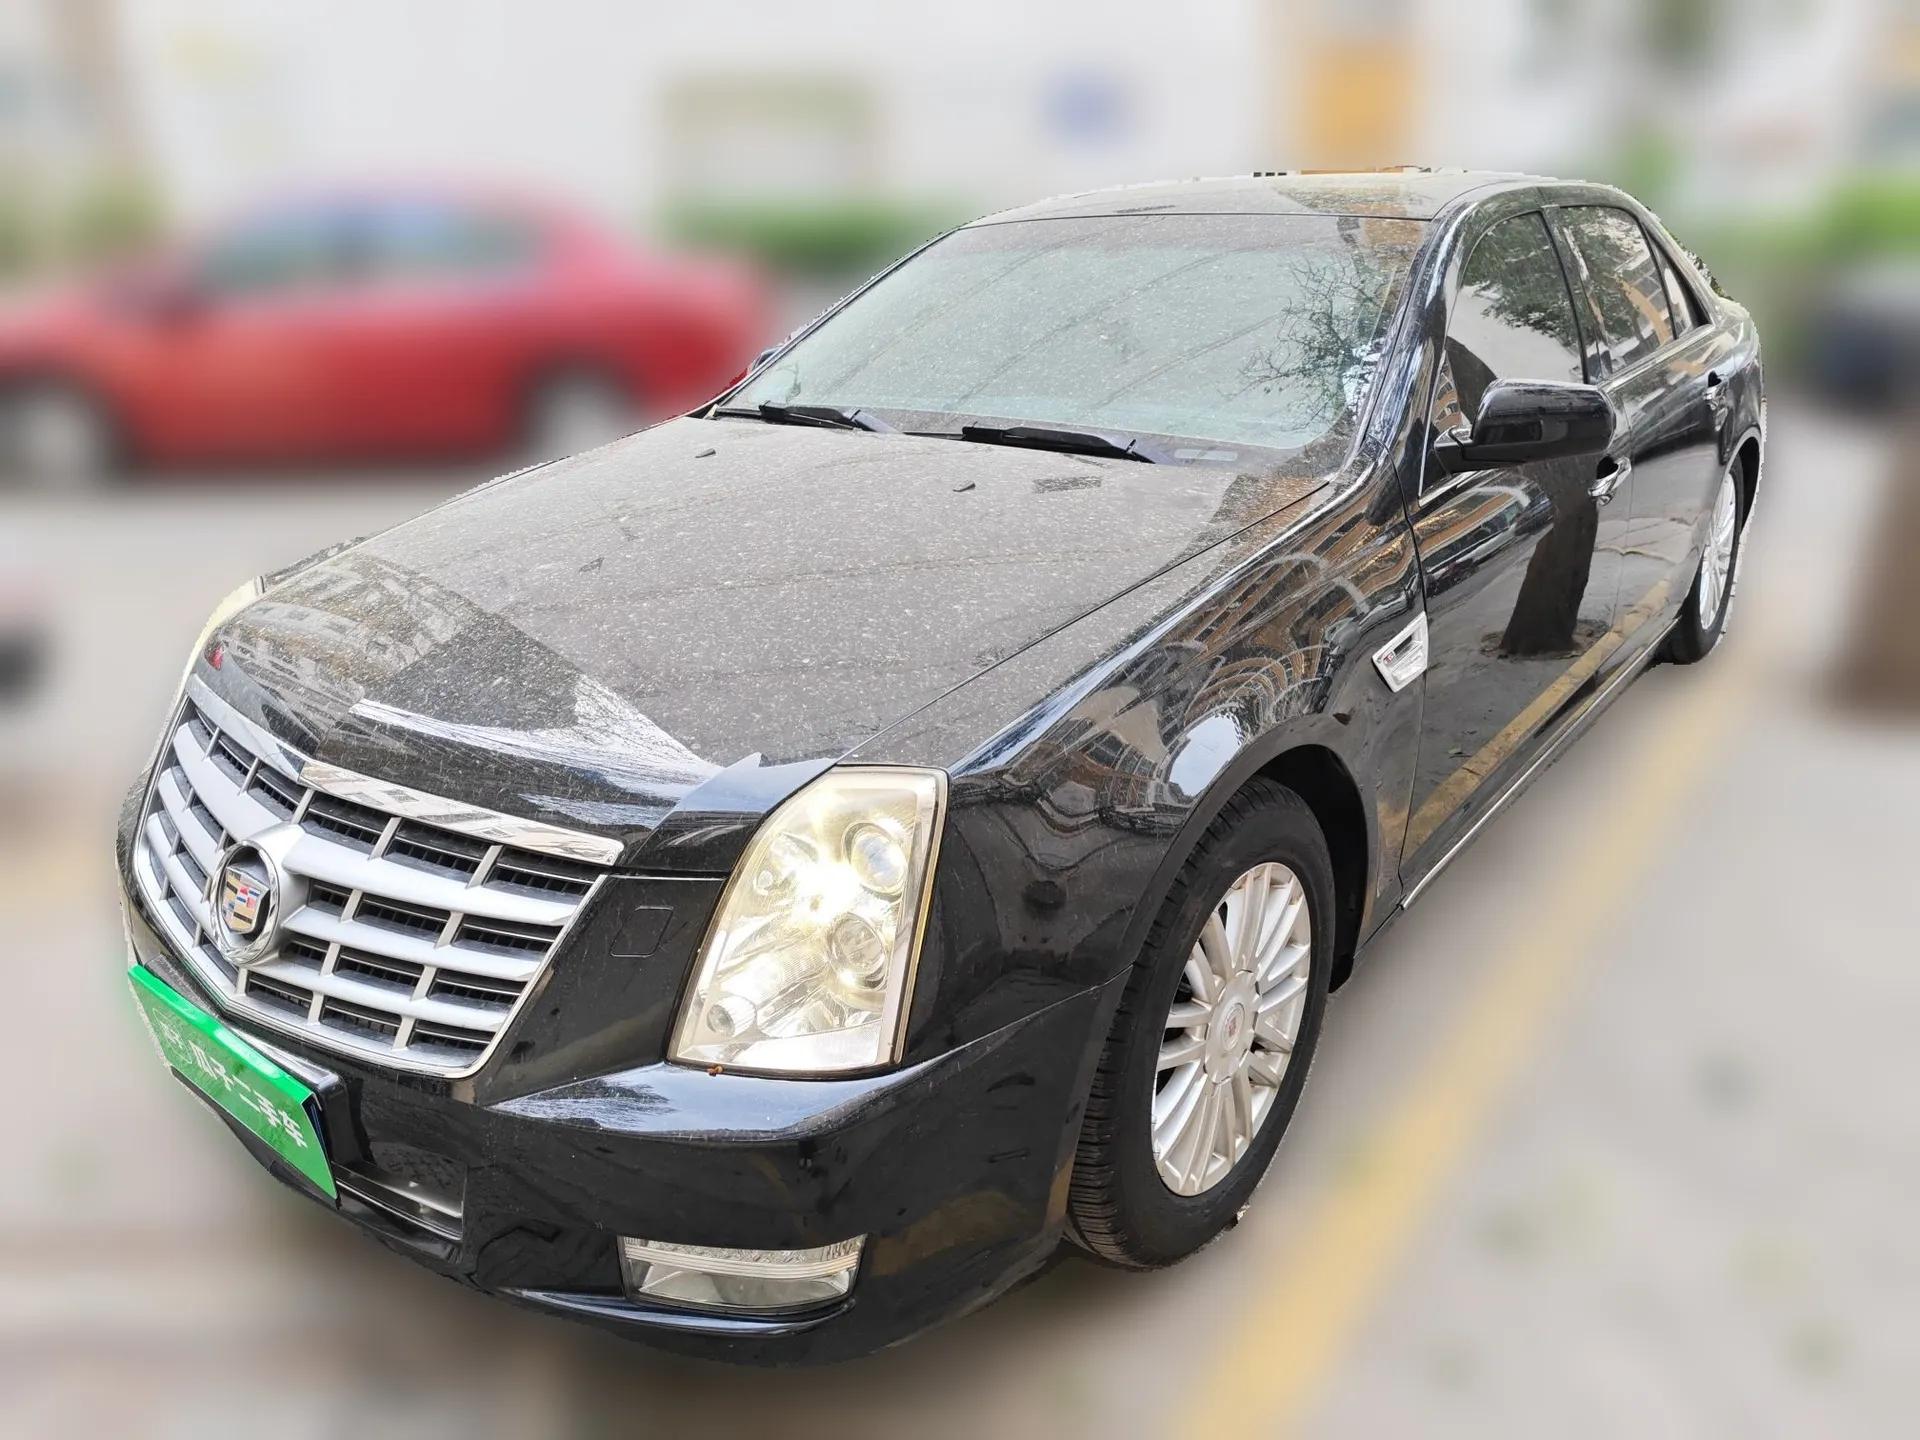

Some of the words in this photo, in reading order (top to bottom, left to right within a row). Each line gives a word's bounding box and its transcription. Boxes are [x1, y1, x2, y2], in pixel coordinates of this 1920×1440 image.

[188, 1040, 308, 1148] 瓜子二手车
